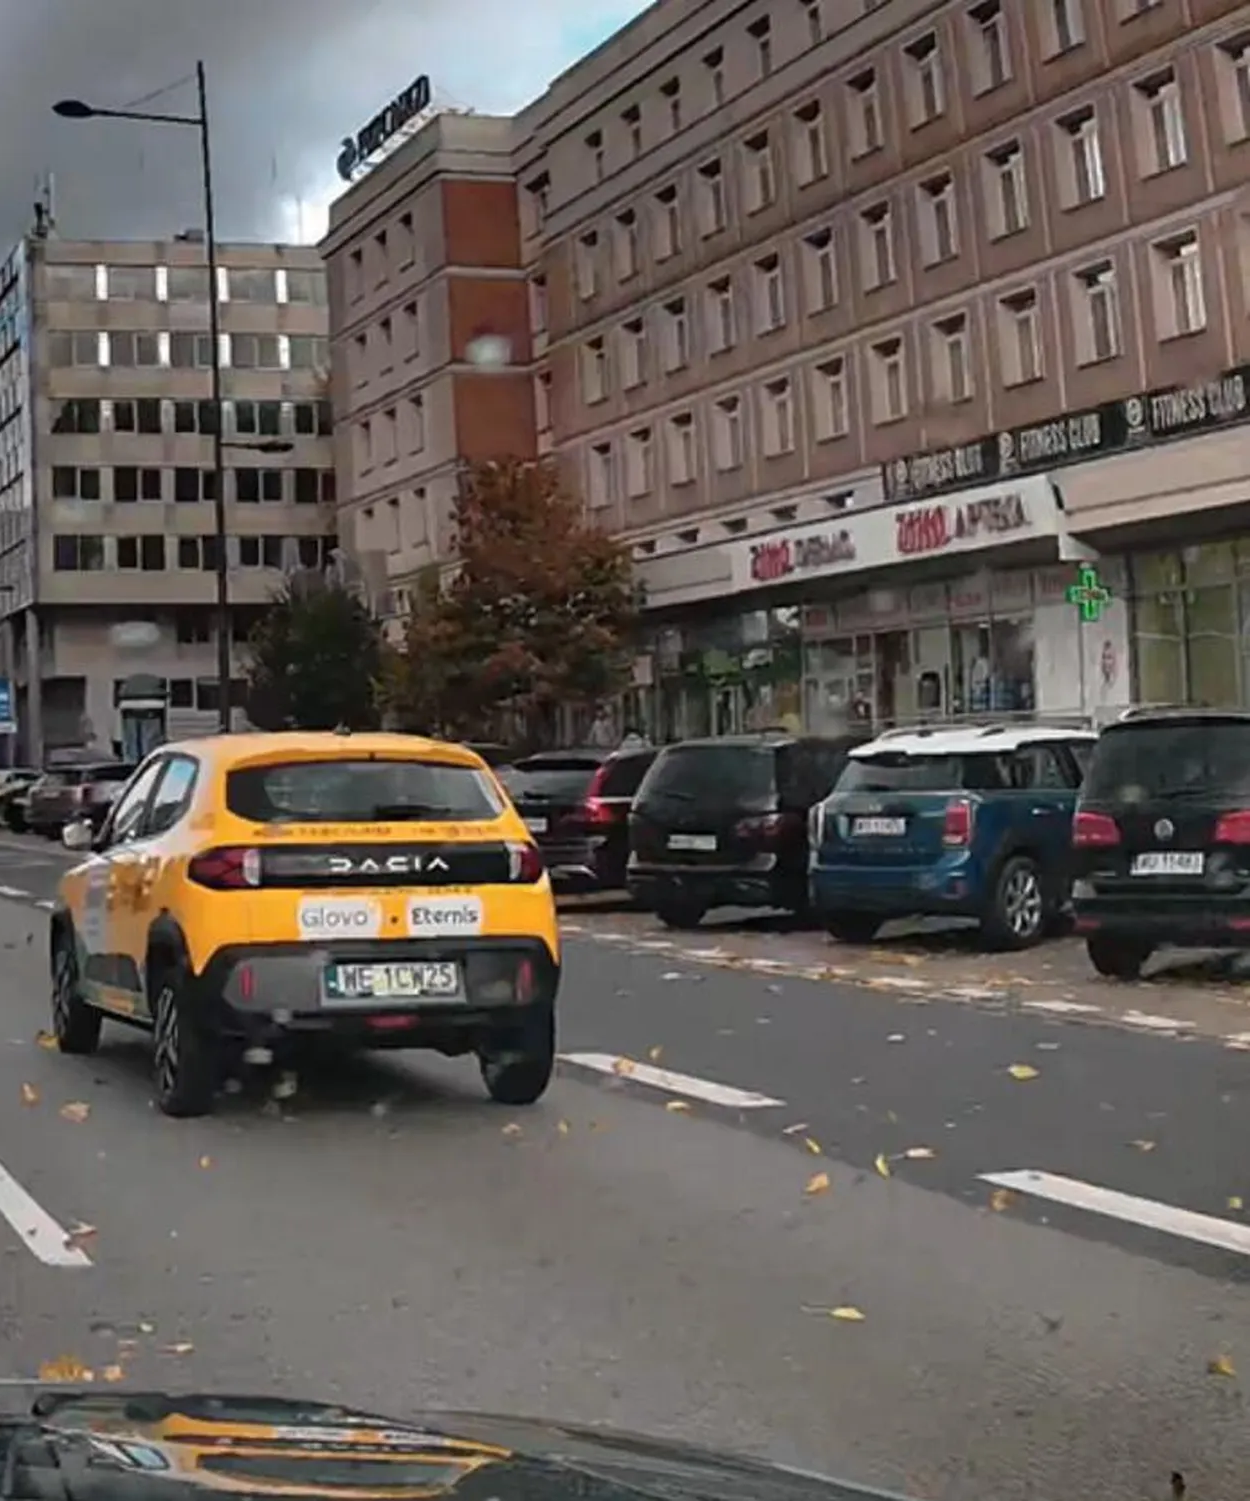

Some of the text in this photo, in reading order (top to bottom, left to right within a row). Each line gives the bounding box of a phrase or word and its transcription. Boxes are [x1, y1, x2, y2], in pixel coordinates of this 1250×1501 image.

[1152, 385, 1206, 430] FITNESS
[1020, 420, 1067, 461] FITNESS
[328, 856, 449, 872] DACIA
[301, 907, 478, 927] Glovo Eternis
